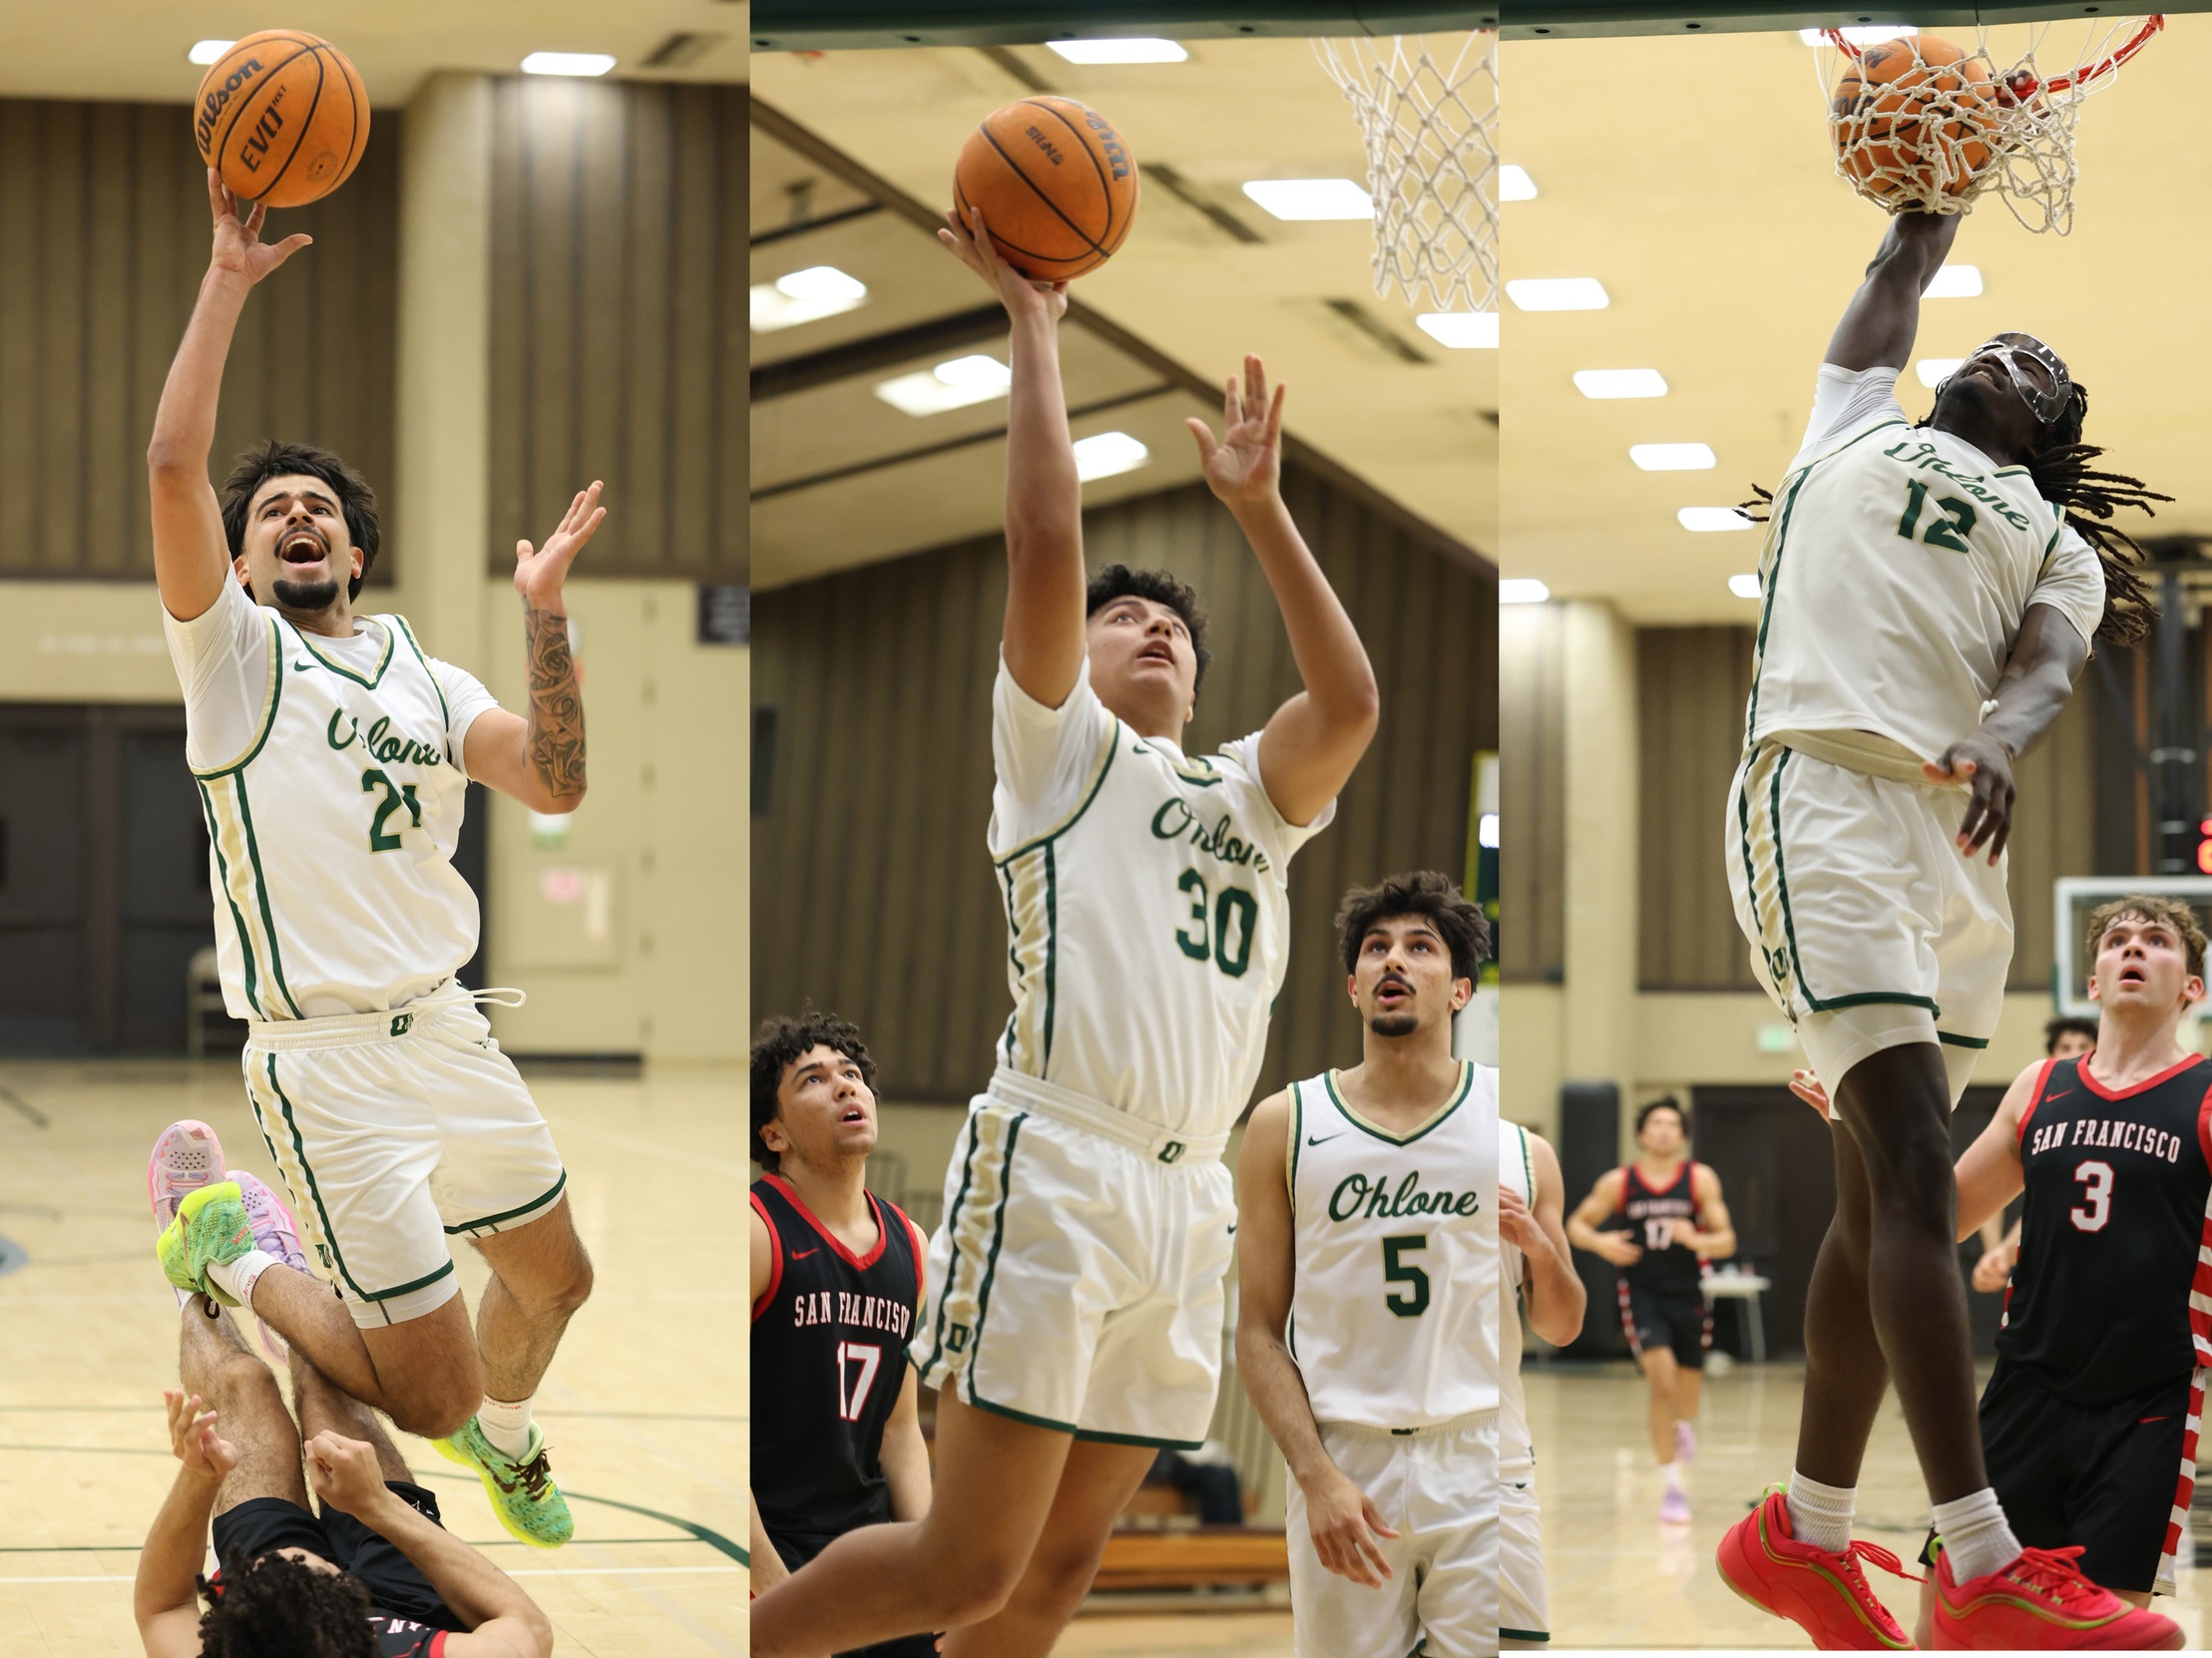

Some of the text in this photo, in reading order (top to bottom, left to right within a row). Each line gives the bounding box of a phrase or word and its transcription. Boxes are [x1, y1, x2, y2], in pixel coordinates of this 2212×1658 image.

[197, 57, 264, 157] Wilson
[1897, 477, 1979, 555] 12
[1175, 867, 1258, 980] 30
[2031, 1119, 2182, 1164] SAN FRANCISCO
[1328, 1170, 1479, 1223] Ohlone
[1644, 1218, 1676, 1251] 17
[2069, 1159, 2115, 1234] 3
[793, 1291, 832, 1328] SAN
[1381, 1233, 1431, 1319] 5
[836, 1339, 882, 1423] 17
